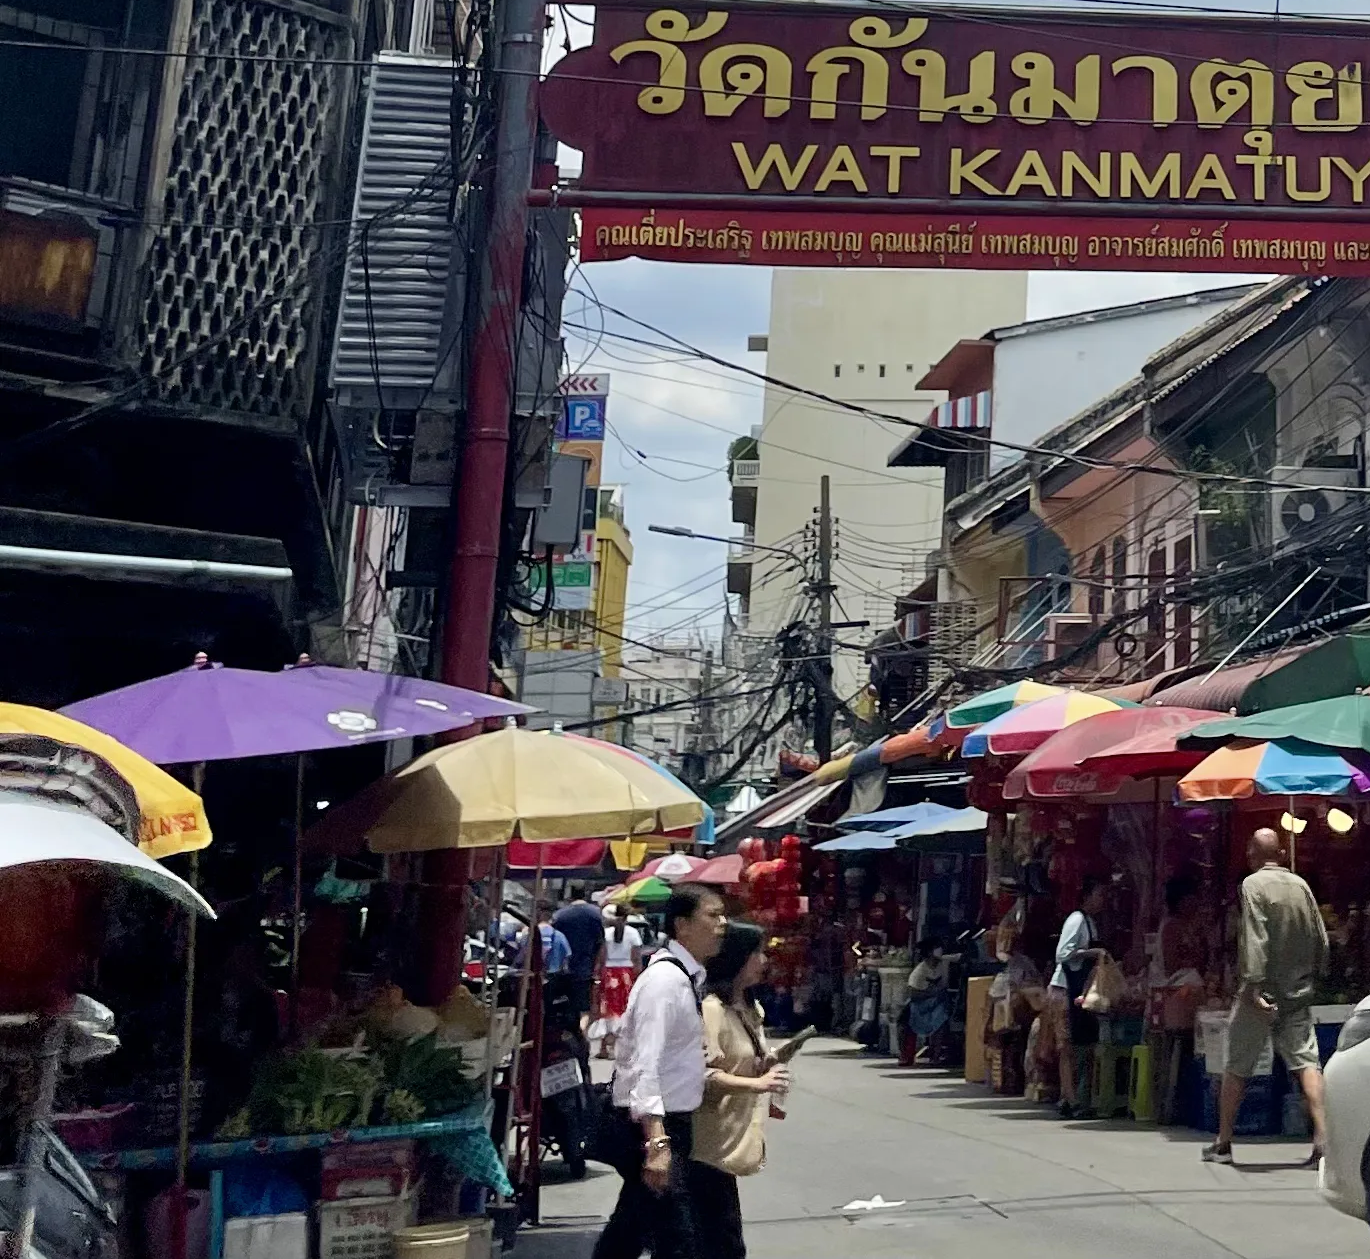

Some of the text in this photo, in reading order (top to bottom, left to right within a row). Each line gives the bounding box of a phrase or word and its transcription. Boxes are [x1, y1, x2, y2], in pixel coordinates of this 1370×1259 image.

[731, 141, 921, 194] WAT
[595, 209, 753, 259] คุณเตี่ยประเสริฐ
[761, 228, 862, 262] เทพสมบุญ
[870, 220, 978, 264] คุณแม่สุนีย์
[981, 232, 1078, 267] เทพสมบุญ
[1088, 221, 1229, 258] อาจารย์สมศักดิ์
[1232, 235, 1326, 271] เทพสมบุญ
[574, 405, 591, 427] P
